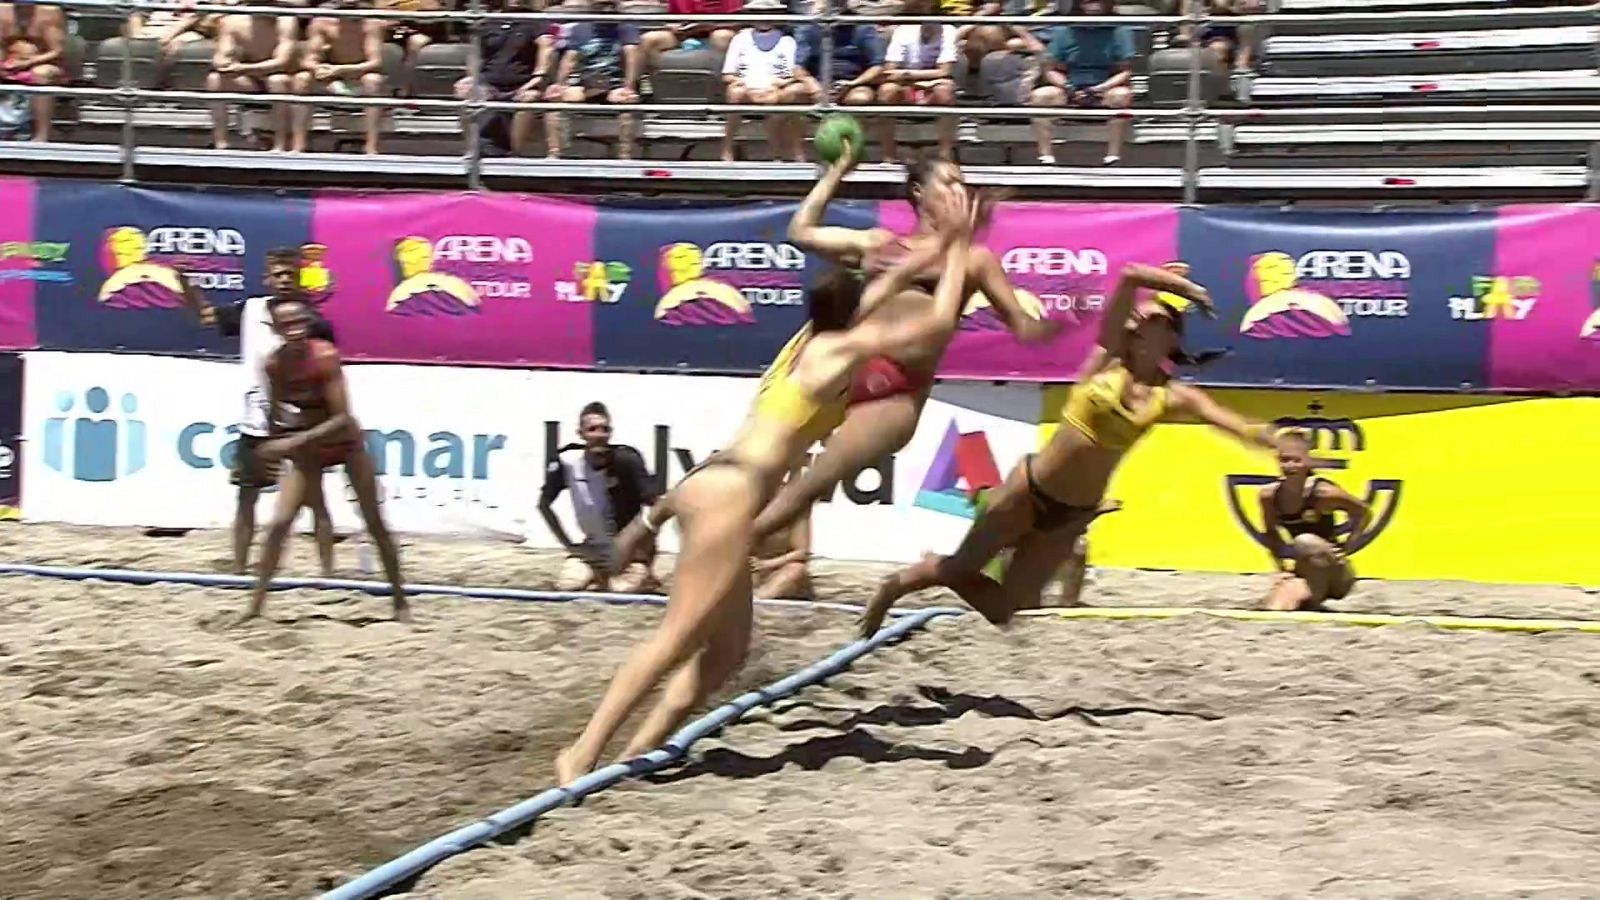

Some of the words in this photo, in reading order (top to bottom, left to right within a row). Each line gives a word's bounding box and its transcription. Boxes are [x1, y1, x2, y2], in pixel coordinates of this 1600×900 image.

[147, 227, 246, 255] ARENA
[433, 235, 533, 263] ARENA
[702, 241, 806, 269] ARENA
[1001, 247, 1107, 275] ARENA
[1295, 250, 1411, 279] ARENA
[181, 272, 245, 290] TOUR
[471, 280, 532, 299] TOUR
[740, 287, 804, 305] TOUR
[1040, 293, 1106, 311] TOUR
[1337, 297, 1409, 317] TOUR
